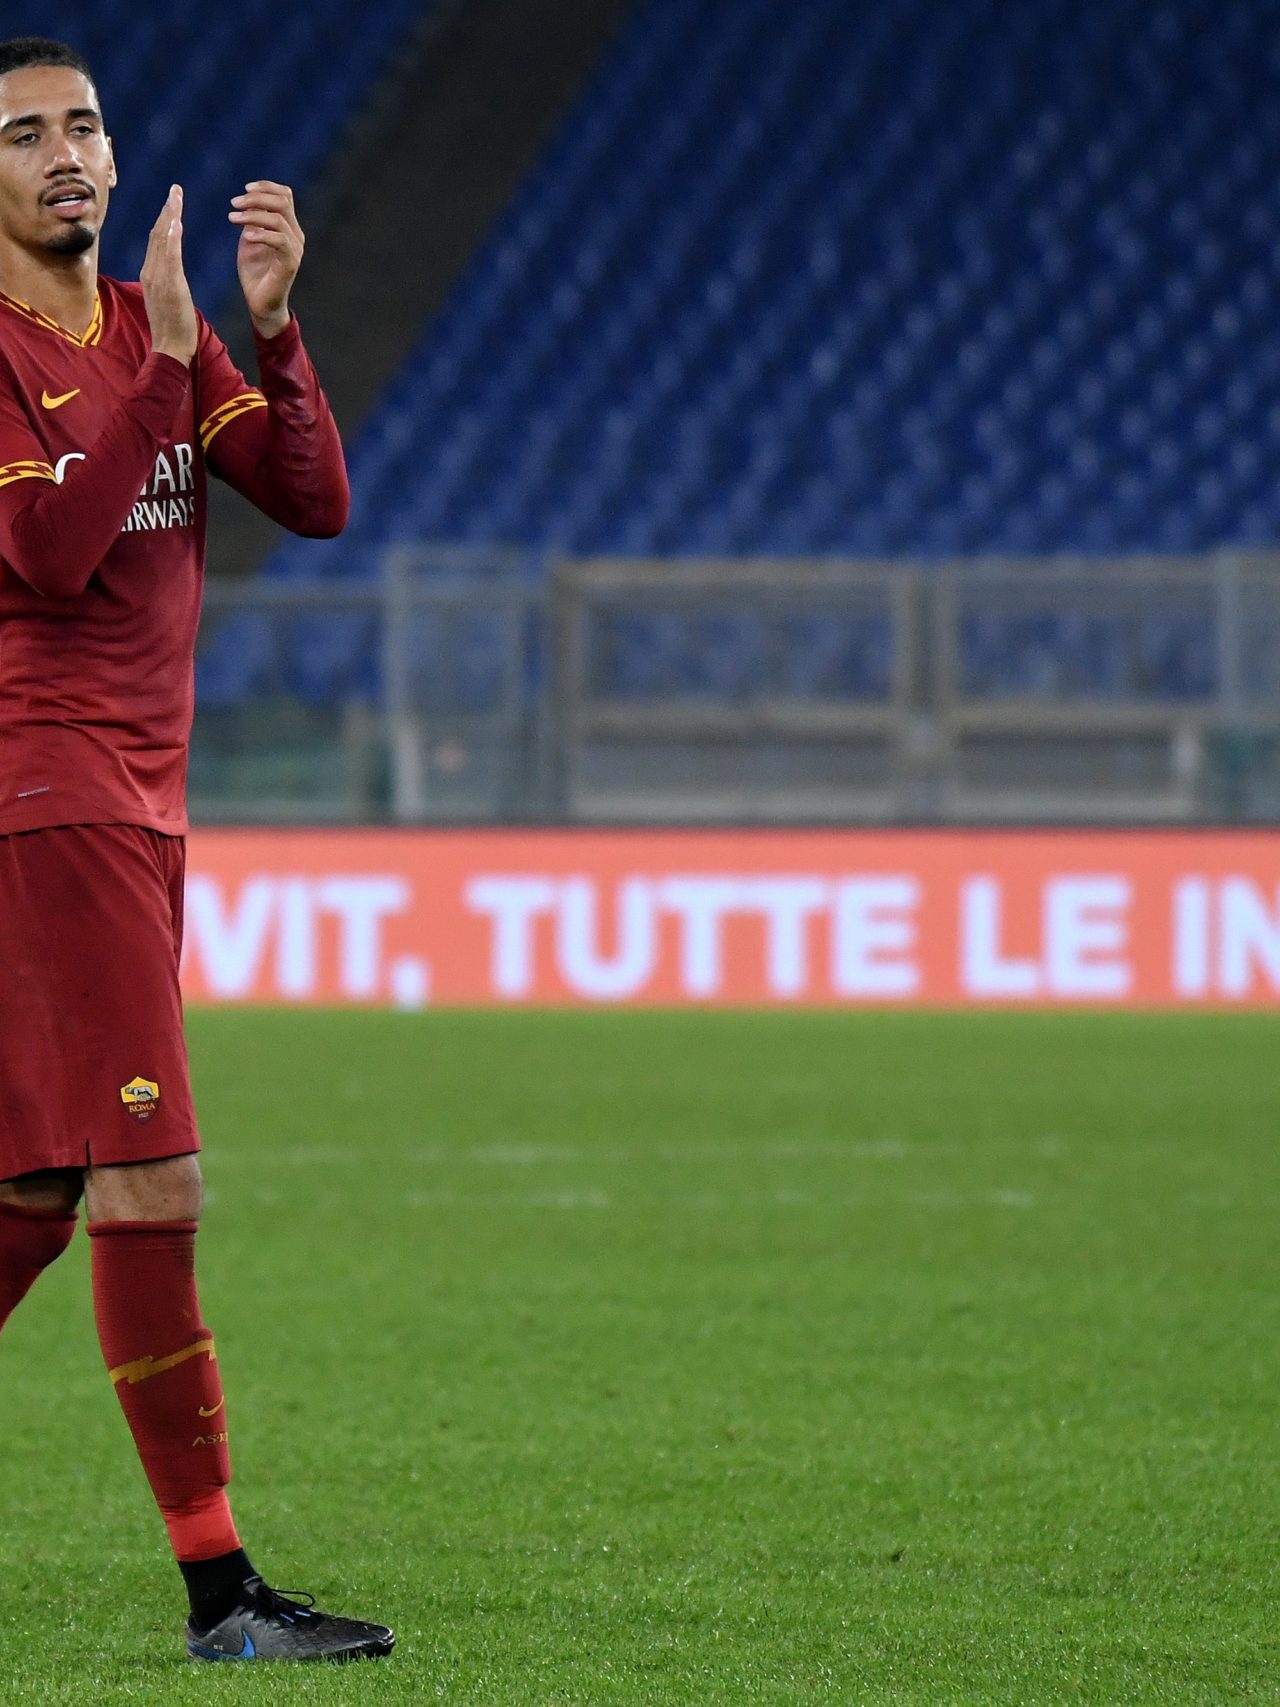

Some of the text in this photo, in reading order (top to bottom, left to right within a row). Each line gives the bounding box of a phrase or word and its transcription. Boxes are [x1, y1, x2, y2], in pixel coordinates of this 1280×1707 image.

[462, 873, 922, 998] TUTTE
[960, 872, 1135, 998] LE
[128, 1102, 156, 1113] ROMA
